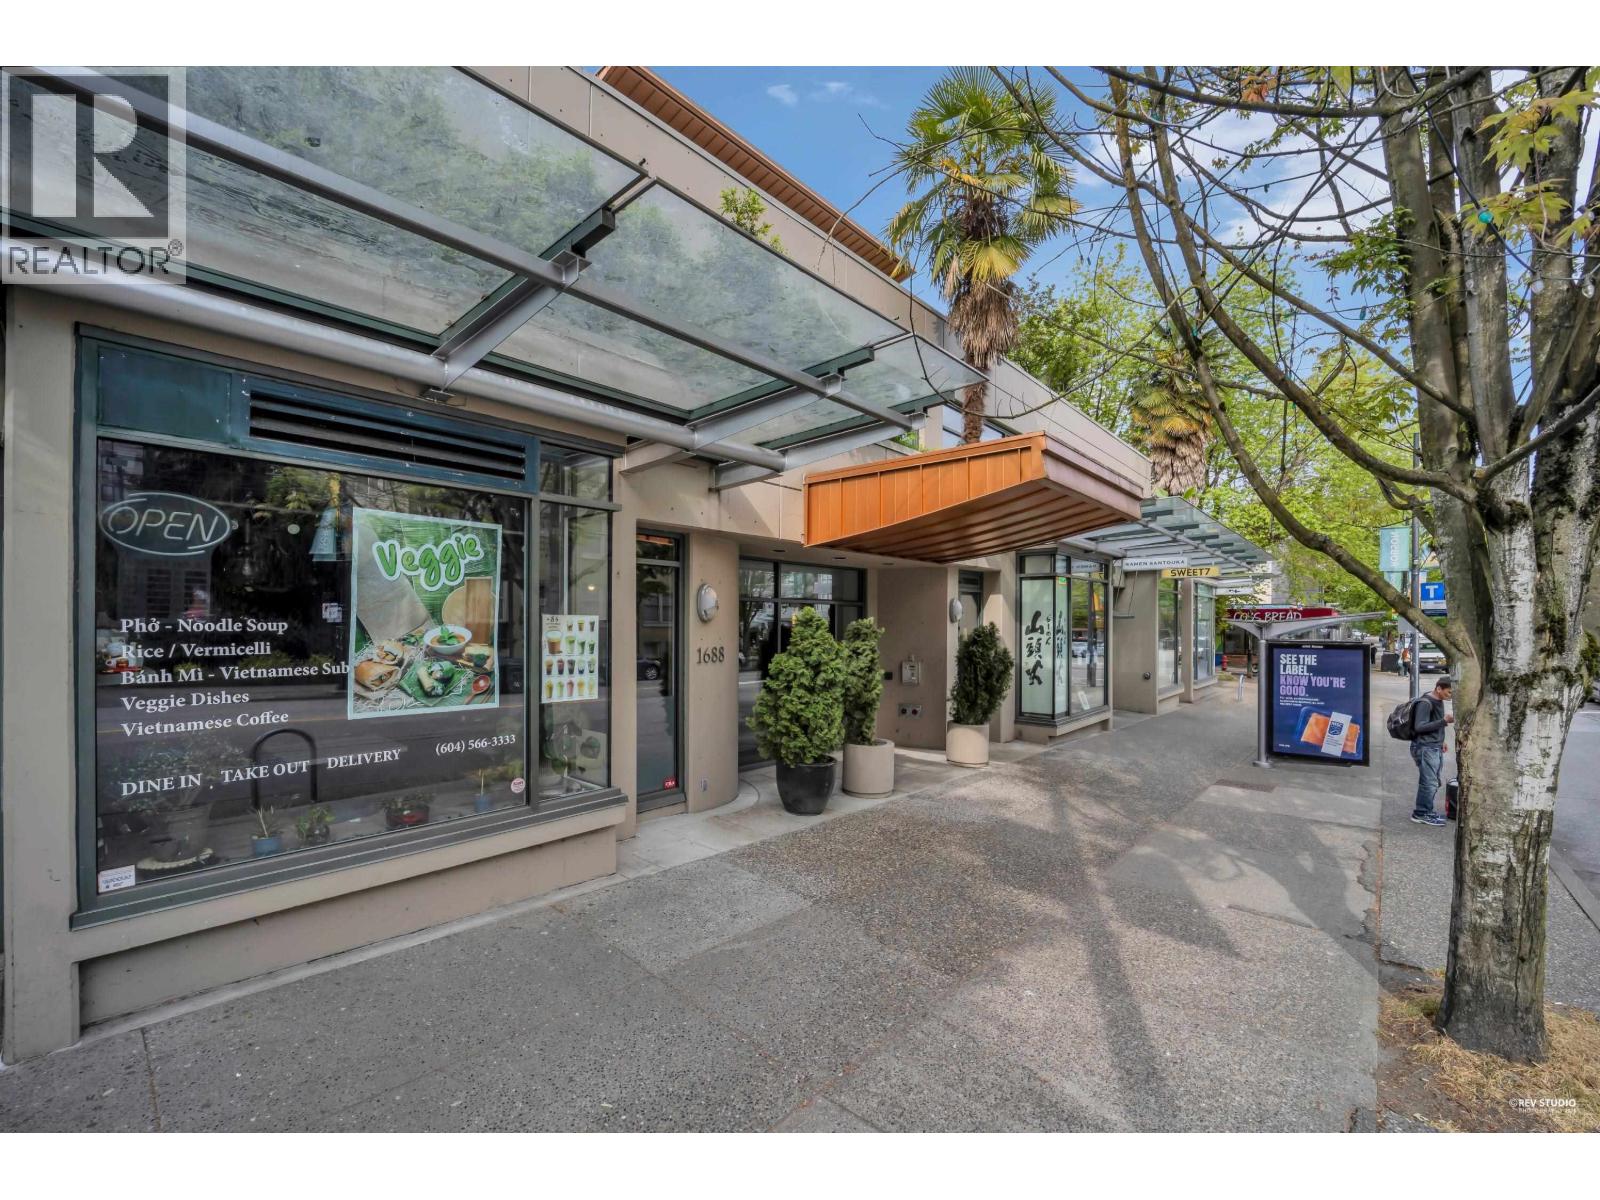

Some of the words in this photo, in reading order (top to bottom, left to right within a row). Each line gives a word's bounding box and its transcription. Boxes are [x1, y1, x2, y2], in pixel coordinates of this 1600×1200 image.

[107, 506, 219, 542] OPEN
[373, 534, 484, 591] Veggie
[1170, 567, 1211, 577] SWEET7
[1425, 585, 1439, 599] T
[120, 617, 161, 633] Phở
[177, 618, 243, 633] Noodle
[246, 619, 289, 635] Soup
[121, 643, 165, 659] Rice
[180, 641, 272, 658] Vermicelli
[696, 646, 725, 664] 1688
[1280, 653, 1298, 665] SEE
[1298, 654, 1318, 666] THE
[121, 668, 173, 685] Bánh
[219, 664, 319, 681] Vietnamese
[1279, 664, 1314, 676] LABEL.
[1279, 674, 1309, 687] KNOW
[1309, 675, 1346, 689] YOU'RE
[1279, 684, 1309, 697] GOOD.
[120, 694, 186, 713] Veggie
[190, 690, 250, 707] Dishes
[120, 717, 232, 737] Vietnamese
[236, 710, 289, 727] Coffee
[435, 740, 466, 756] (604)
[467, 734, 517, 751] 566-3333
[121, 776, 175, 796] DINE
[179, 773, 201, 789] IN
[220, 765, 270, 783] TAKE
[272, 760, 310, 776] OUT
[327, 749, 402, 769] DELIVERY
